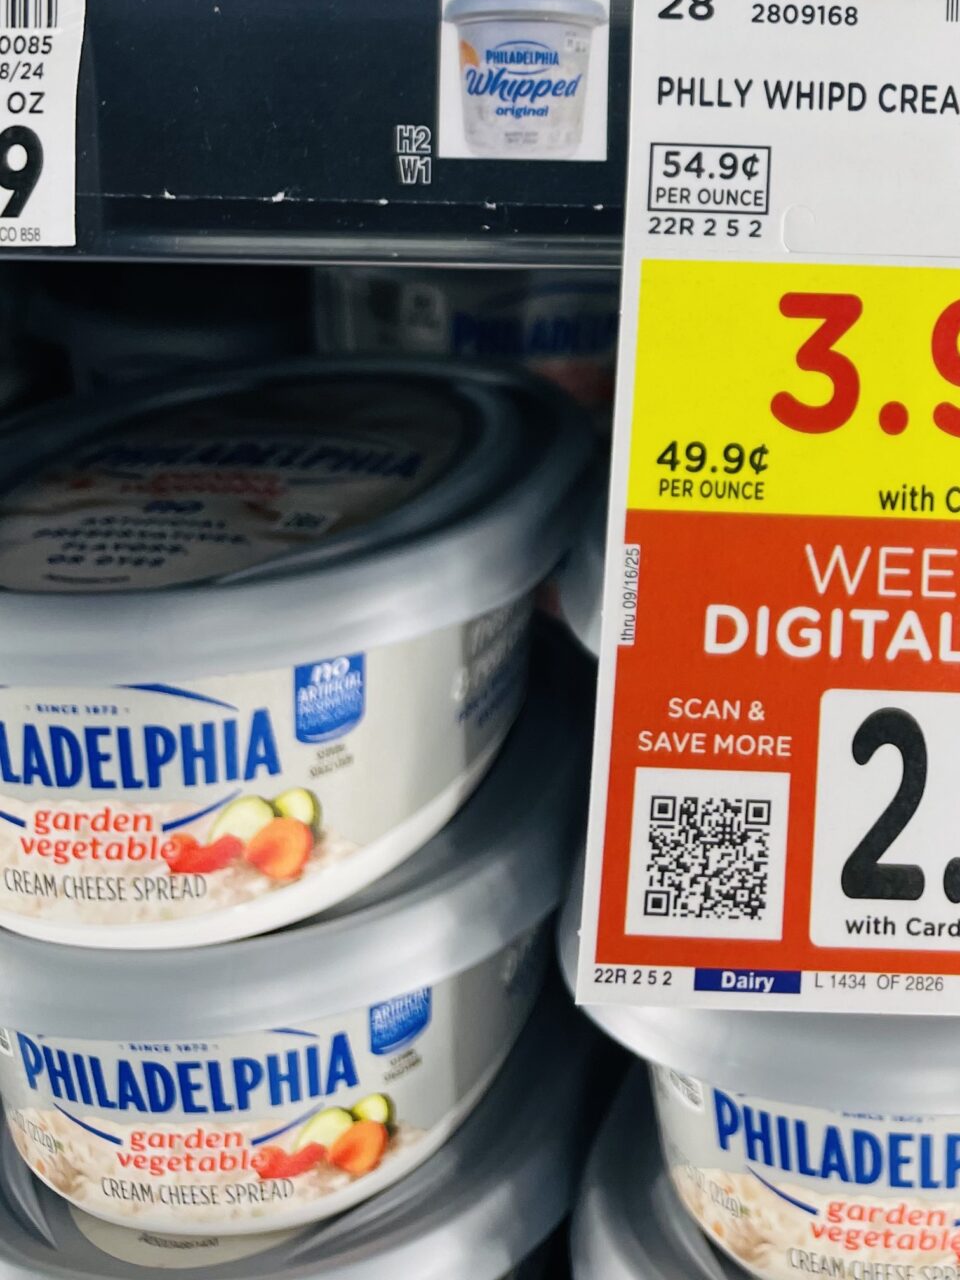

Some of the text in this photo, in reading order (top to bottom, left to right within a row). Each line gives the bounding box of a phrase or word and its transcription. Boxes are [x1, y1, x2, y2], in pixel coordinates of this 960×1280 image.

[751, 3, 858, 26] 2809168
[486, 50, 559, 65] PHILADELPHIA
[465, 67, 583, 103] Whipped
[657, 76, 752, 108] PHLLY
[763, 79, 867, 112] WHIPD
[7, 92, 45, 113] OZ
[496, 106, 548, 118] original
[397, 125, 431, 153] H2
[0, 125, 44, 218] 9
[400, 157, 431, 184] W1
[662, 150, 760, 180] 54.9¢
[655, 187, 764, 207] PER OUNCE
[0, 227, 41, 242] CO 858
[655, 440, 769, 477] 49.9¢
[658, 478, 765, 502] PER OUNCE
[878, 486, 936, 513] with
[620, 547, 640, 641] thru 09/16/25
[667, 697, 765, 722] SCAN &
[637, 731, 793, 758] SAVE MORE
[33, 806, 154, 836] garden
[20, 835, 182, 865] vegetable
[3, 868, 207, 902] CREAM CHEESE SPREAD
[845, 916, 897, 936] with
[720, 971, 775, 992] Dairy
[815, 973, 823, 988] L
[831, 974, 866, 990] 1434
[876, 975, 899, 990] OF
[905, 976, 944, 992] 2826
[17, 1030, 360, 1115] PHILADELPHIA
[129, 1128, 244, 1152] garden
[116, 1149, 270, 1176] vegetable
[102, 1180, 294, 1205] CREAM CHEESE SPREAD
[826, 1200, 947, 1227] garden
